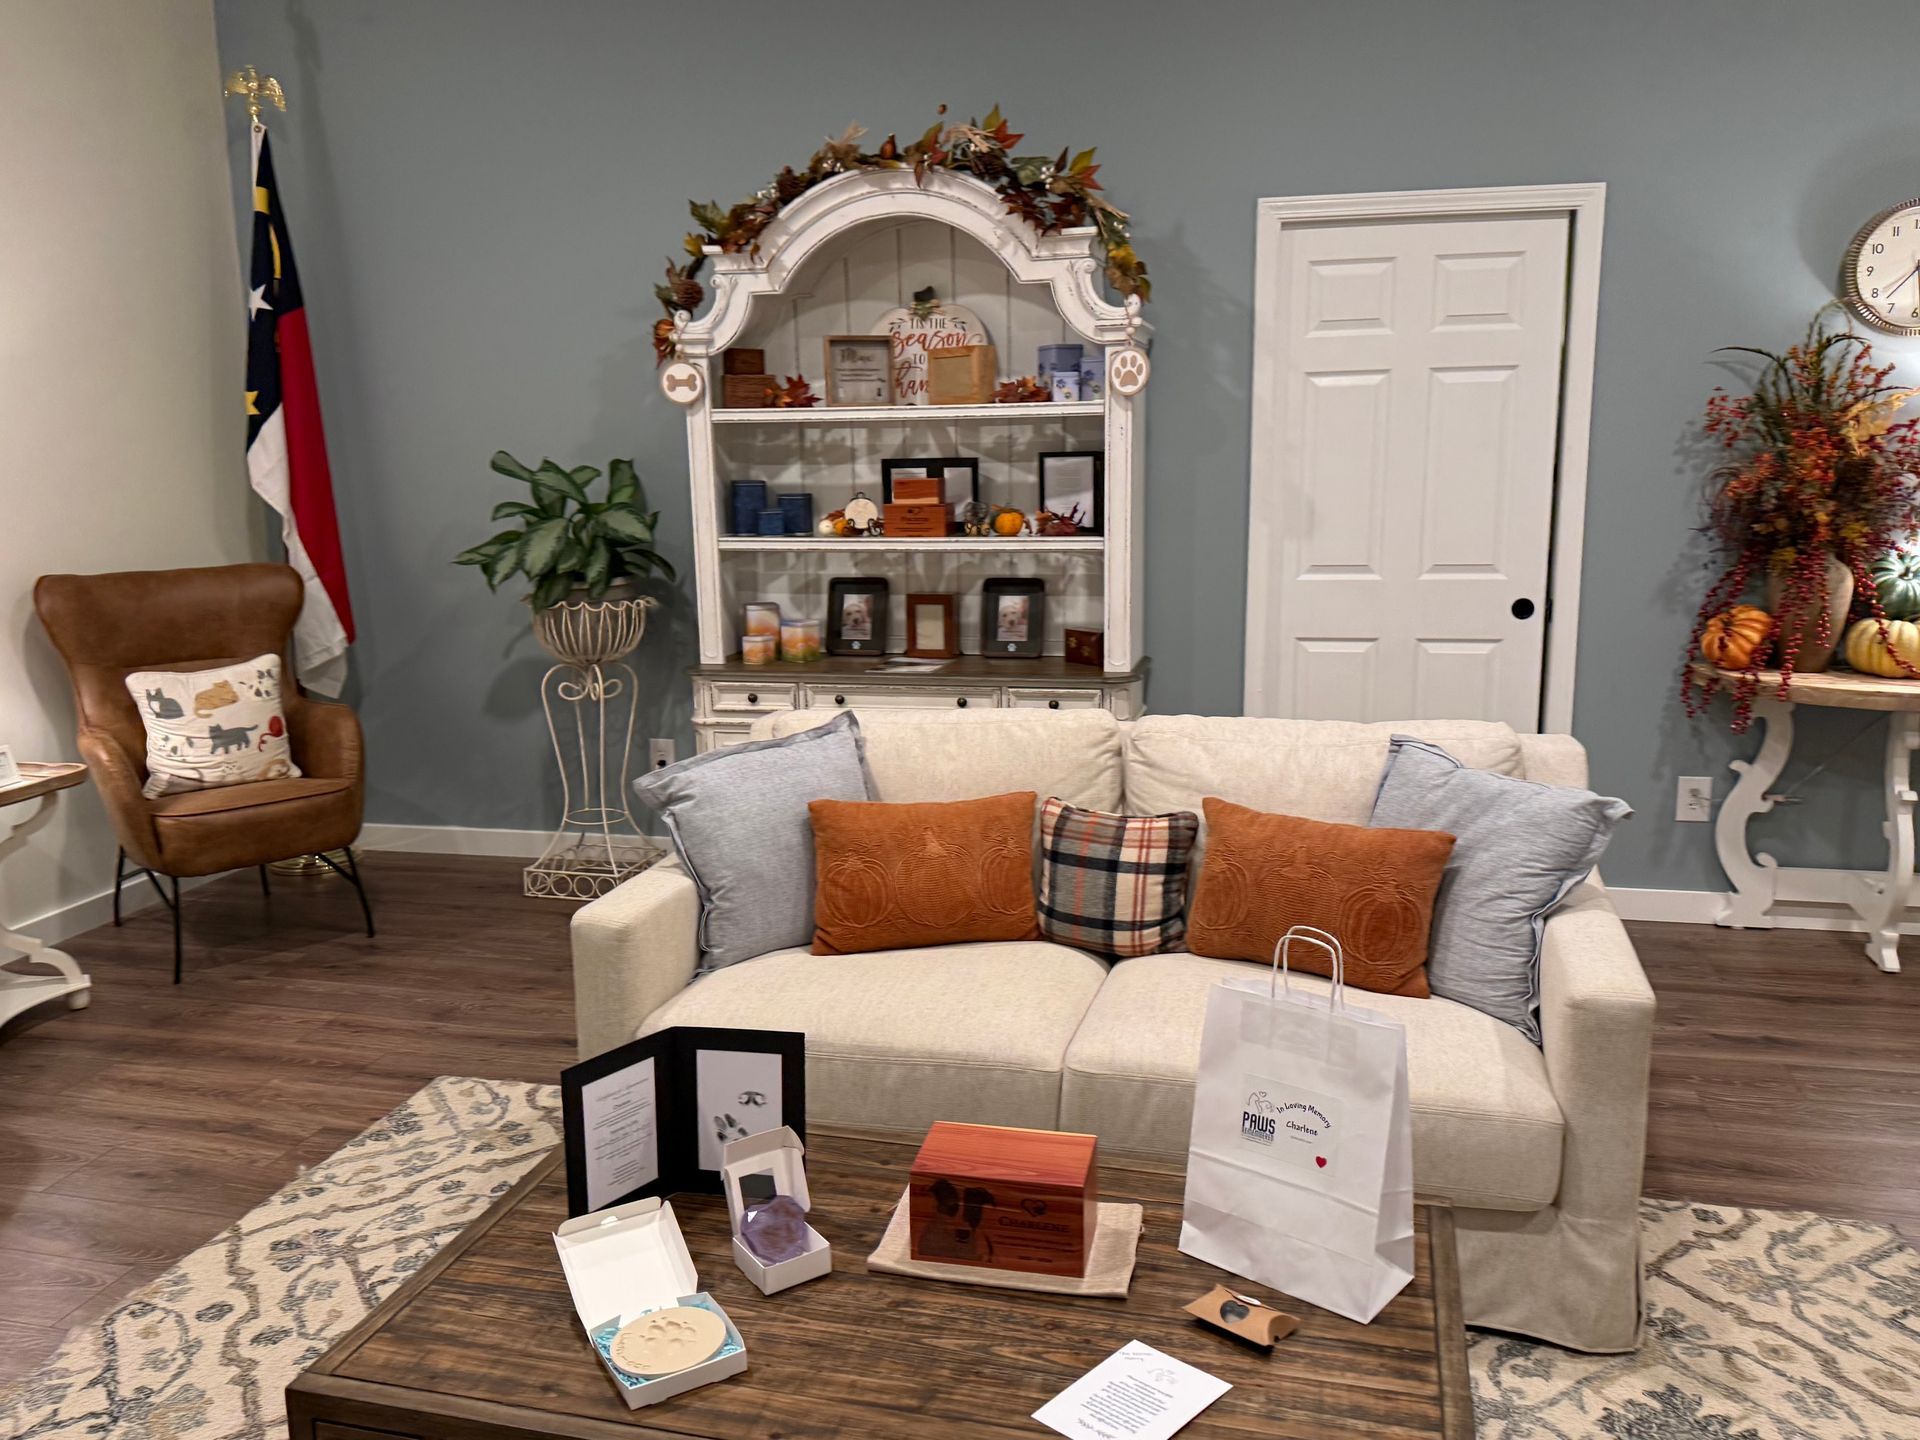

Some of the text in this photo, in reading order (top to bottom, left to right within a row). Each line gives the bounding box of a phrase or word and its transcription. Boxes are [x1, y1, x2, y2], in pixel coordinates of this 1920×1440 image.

[1892, 226, 1900, 237] 11
[1872, 243, 1884, 255] 10
[1866, 265, 1874, 277] 9
[1871, 287, 1879, 298] 8
[1887, 302, 1896, 313] 7
[1911, 307, 1919, 318] 6
[929, 317, 947, 329] THE
[912, 353, 926, 365] TO
[1276, 1102, 1332, 1129] In Loving Memory
[1242, 1111, 1276, 1135] PAWS
[1286, 1121, 1318, 1136] Charlene
